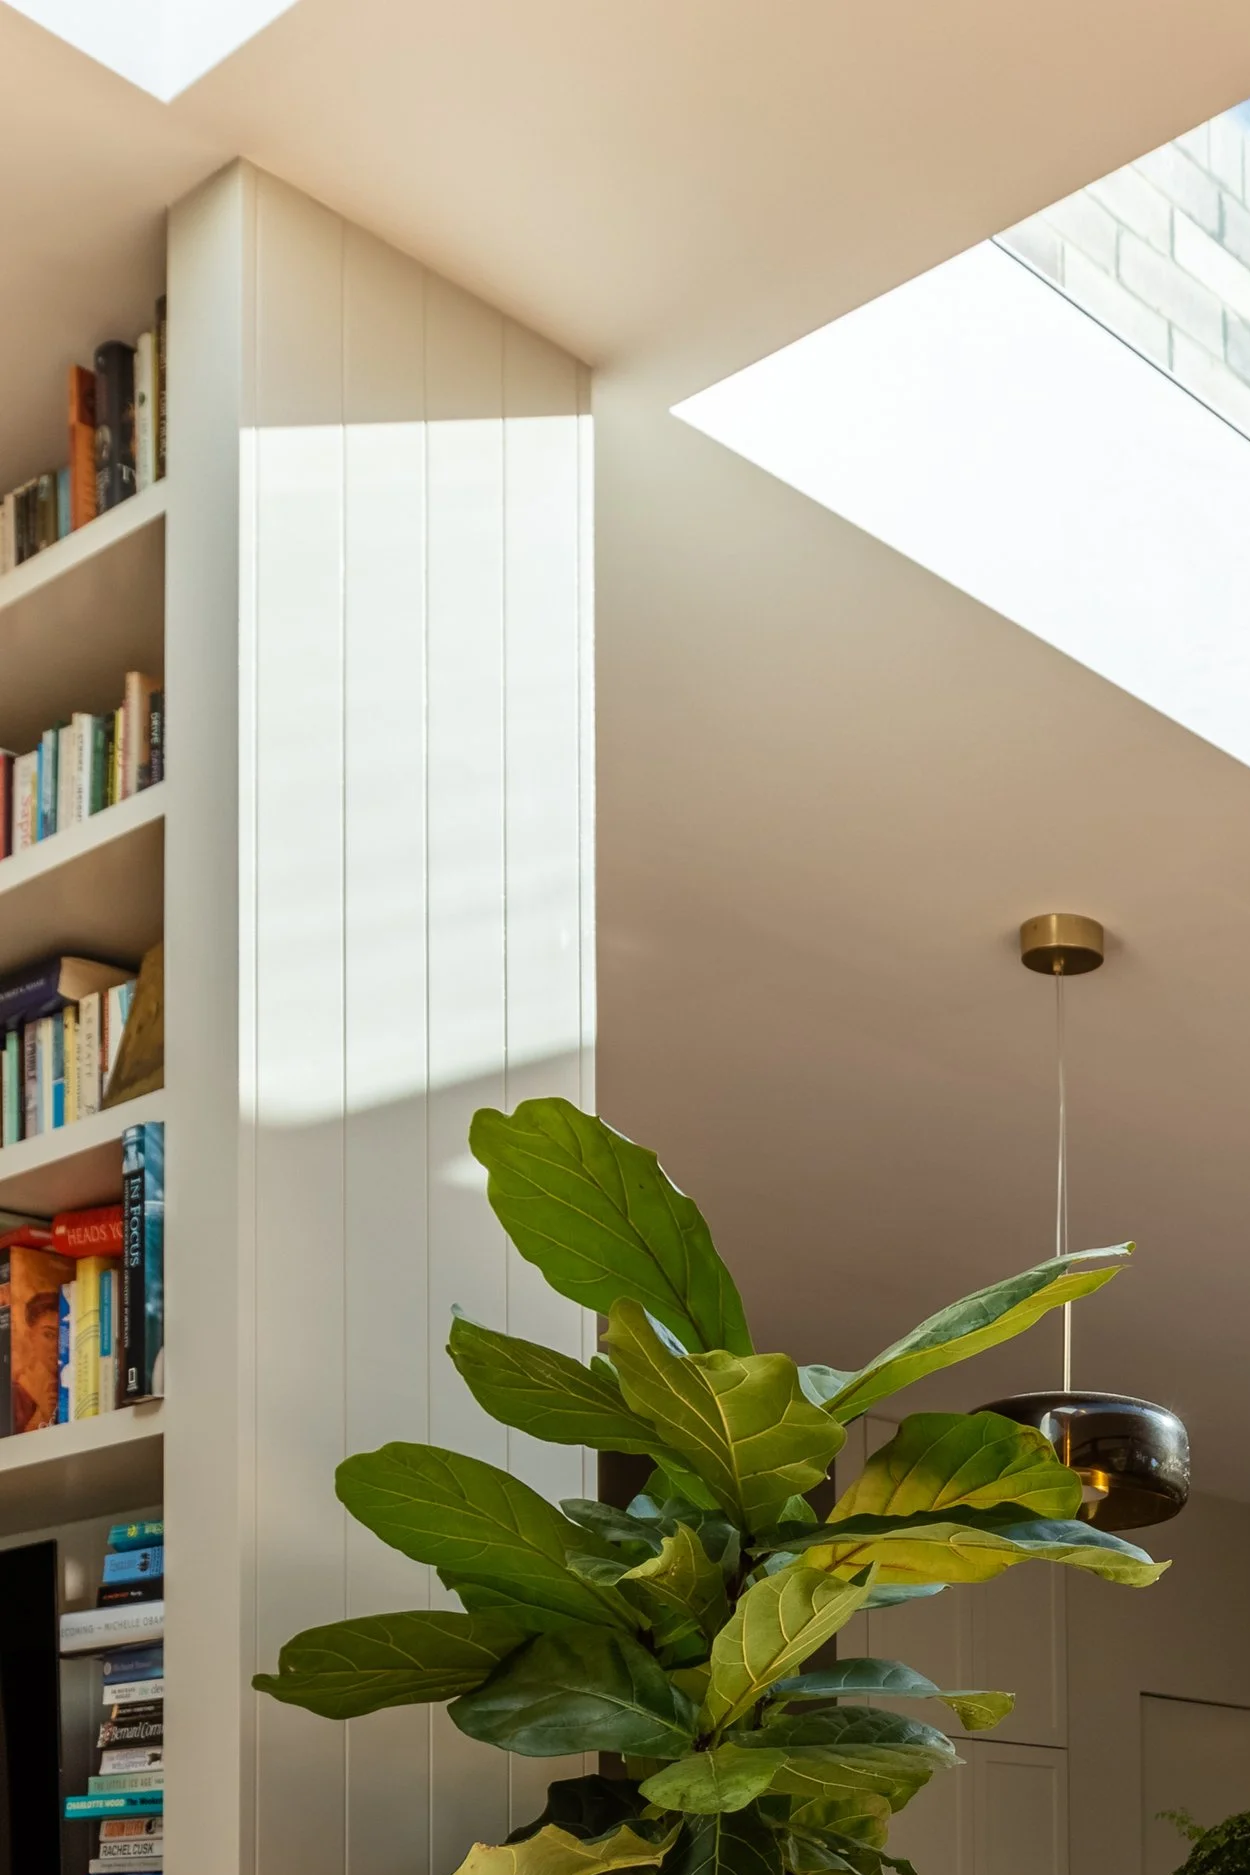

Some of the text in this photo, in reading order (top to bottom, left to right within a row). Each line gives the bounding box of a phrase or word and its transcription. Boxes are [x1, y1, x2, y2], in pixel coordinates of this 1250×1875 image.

[129, 1176, 141, 1267] IN FOCUS
[67, 1226, 107, 1247] HEADS
[104, 1618, 140, 1632] MICHELLE
[111, 1722, 142, 1742] Bernard
[141, 1776, 152, 1787] AGE
[66, 1800, 104, 1810] CHARLOTTE
[104, 1798, 125, 1808] WOOD
[102, 1842, 153, 1857] RACHEL CUSK
